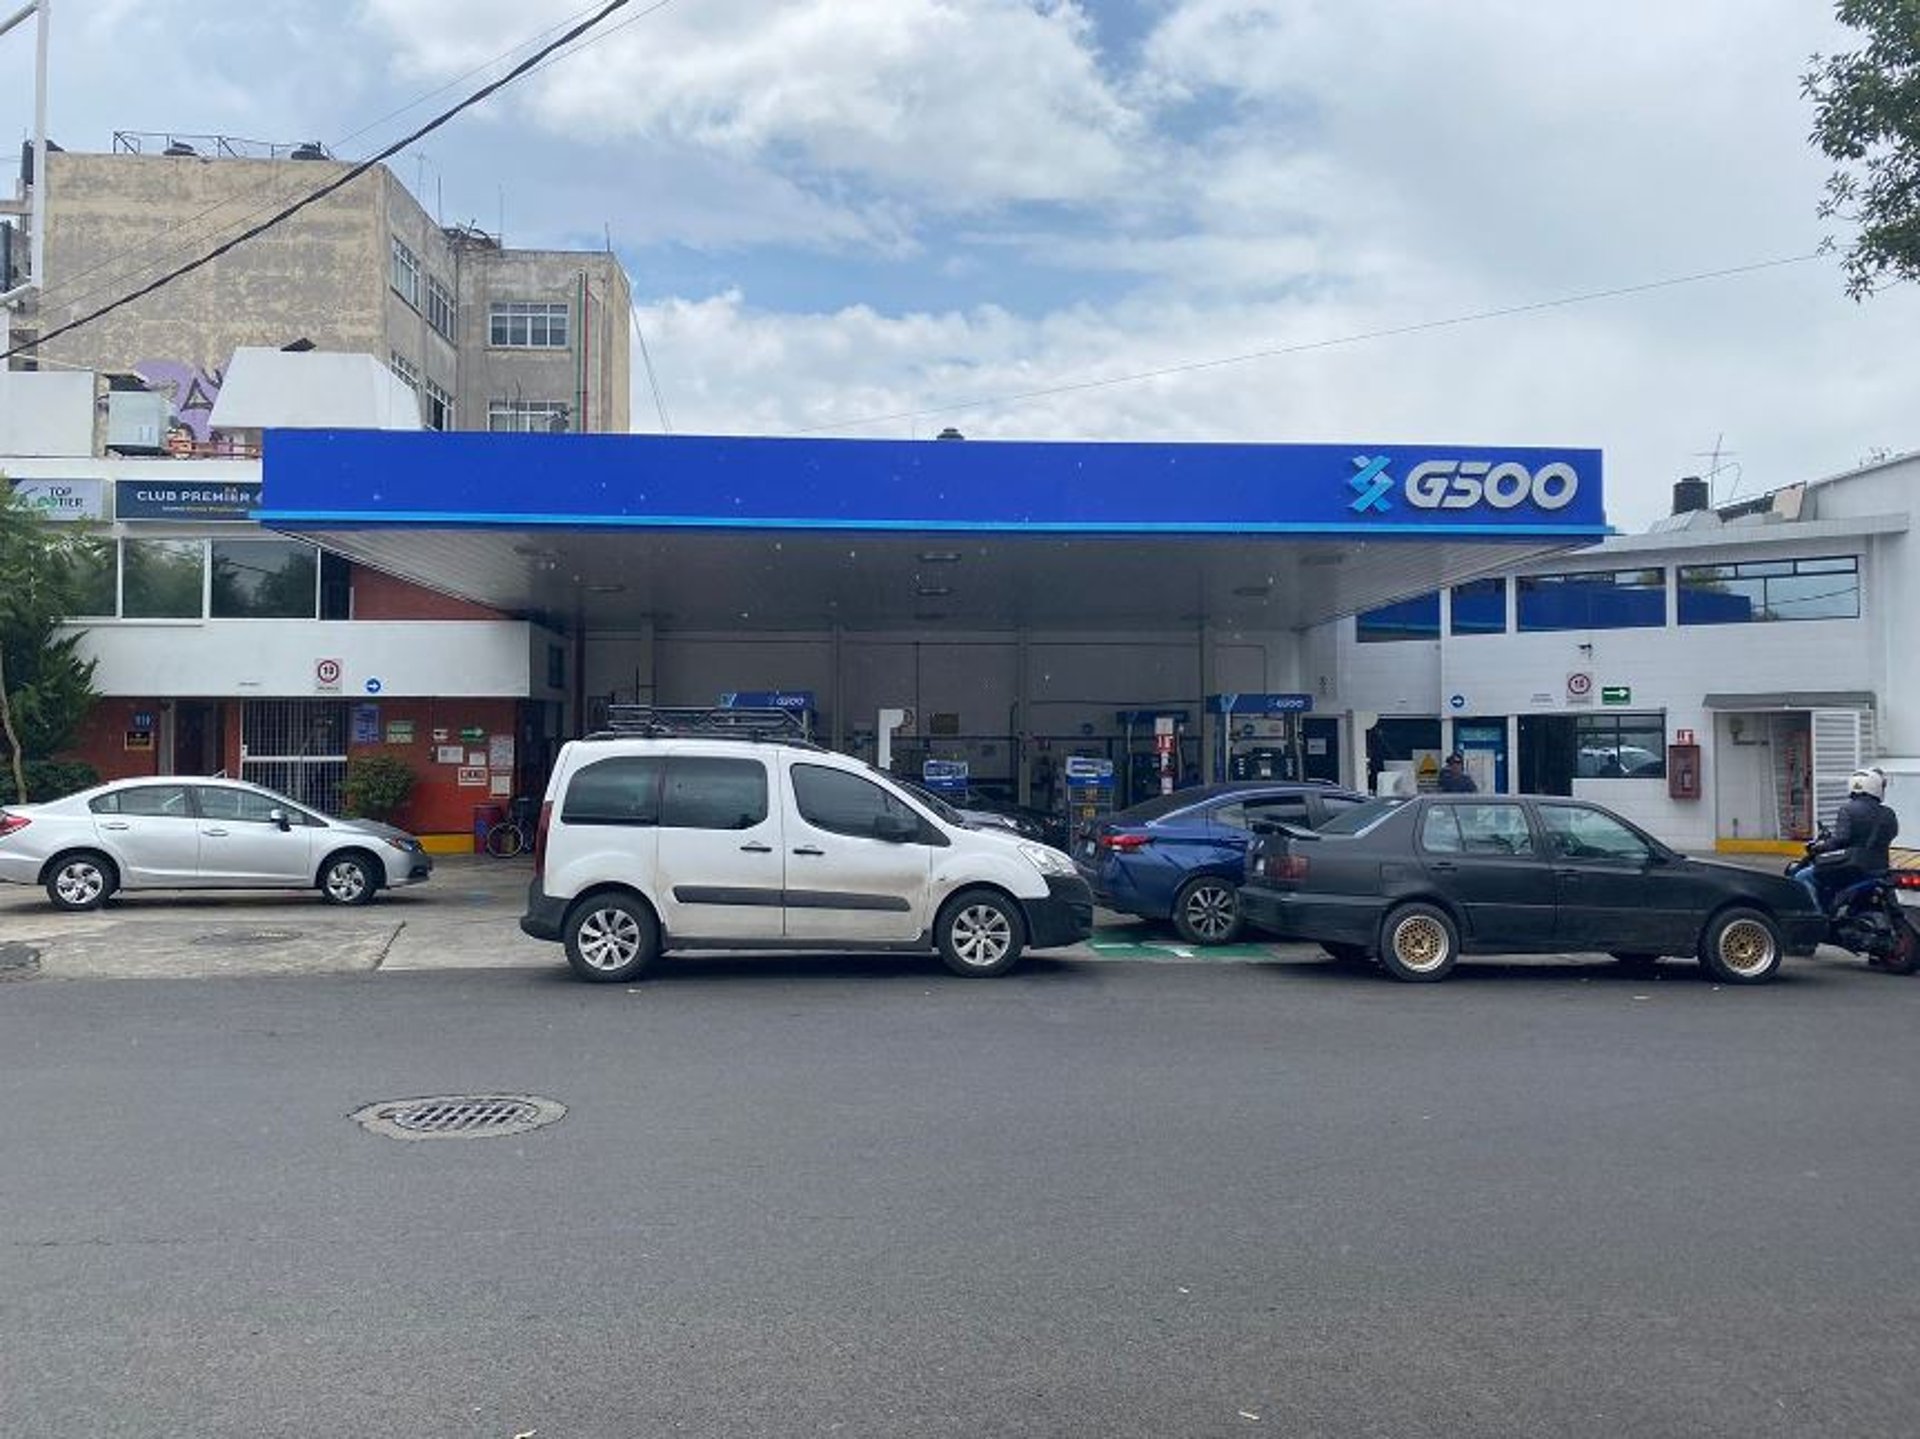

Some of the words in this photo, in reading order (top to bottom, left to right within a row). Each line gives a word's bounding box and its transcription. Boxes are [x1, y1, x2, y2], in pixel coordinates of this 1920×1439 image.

[1405, 460, 1579, 510] G500
[49, 486, 72, 497] TOP
[136, 490, 177, 502] CLUB
[181, 490, 250, 502] PREMIER
[59, 497, 84, 508] TIER
